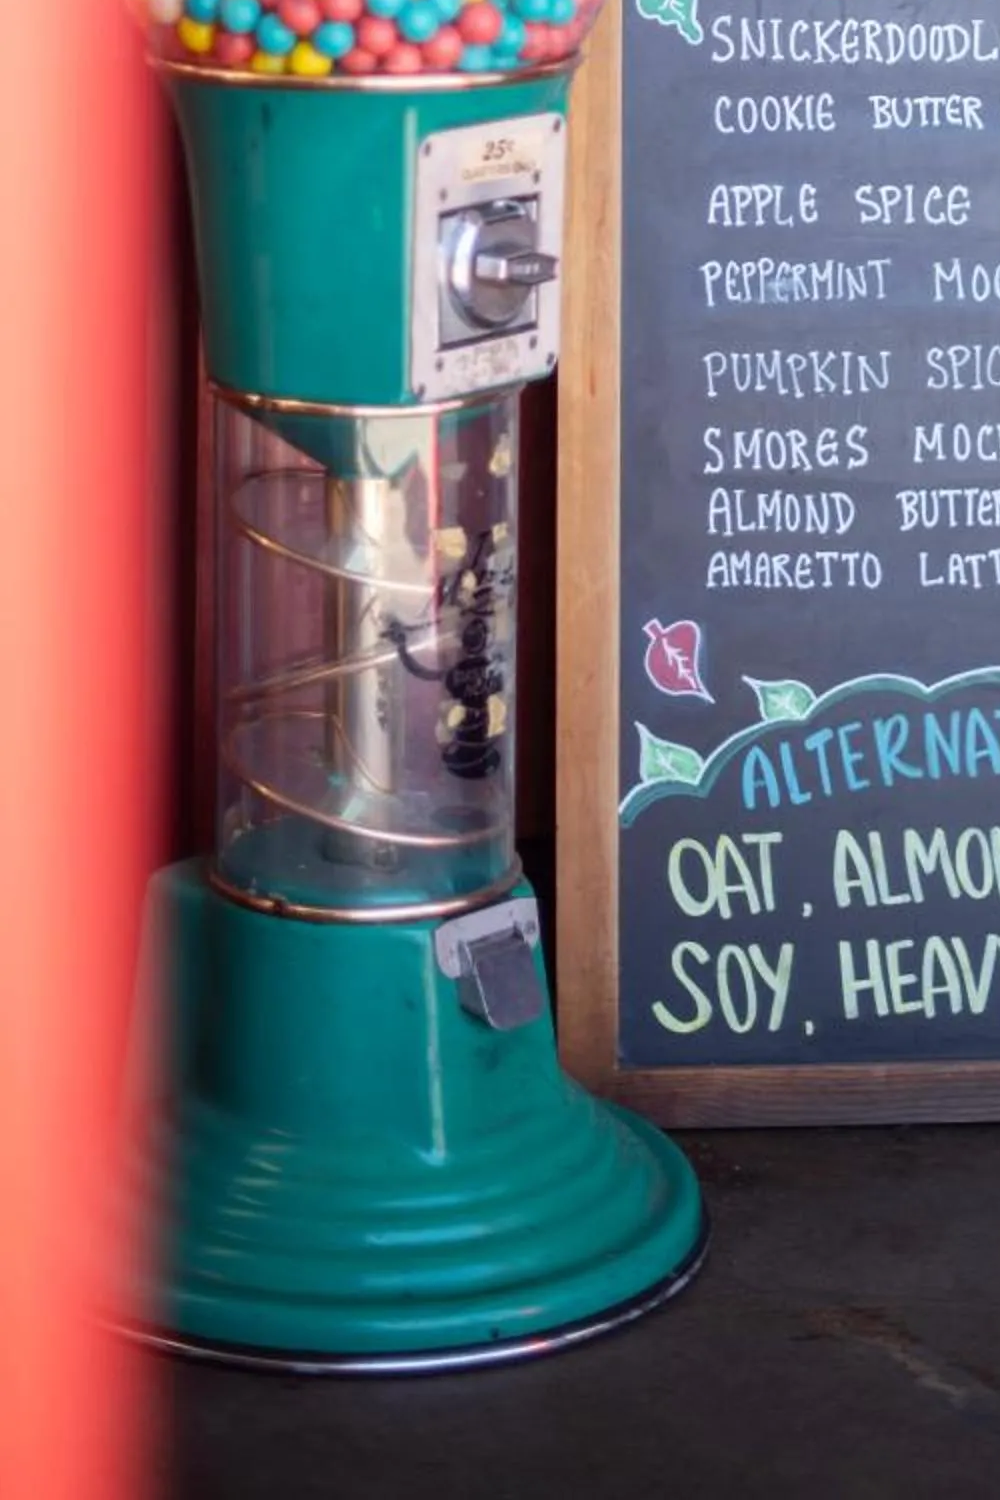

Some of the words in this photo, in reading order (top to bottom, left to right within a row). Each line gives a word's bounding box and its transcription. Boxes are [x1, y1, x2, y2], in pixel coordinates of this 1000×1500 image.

[714, 93, 836, 133] COOKIE
[869, 94, 984, 132] BUTTER
[707, 184, 818, 227] APPLE
[855, 184, 971, 226] SPICE
[700, 257, 892, 307] PEPPERMINT
[703, 349, 891, 398] PUMPKIN
[703, 424, 869, 474] SMORES
[708, 487, 856, 536] ALMOND
[705, 550, 882, 589] AMARETTO
